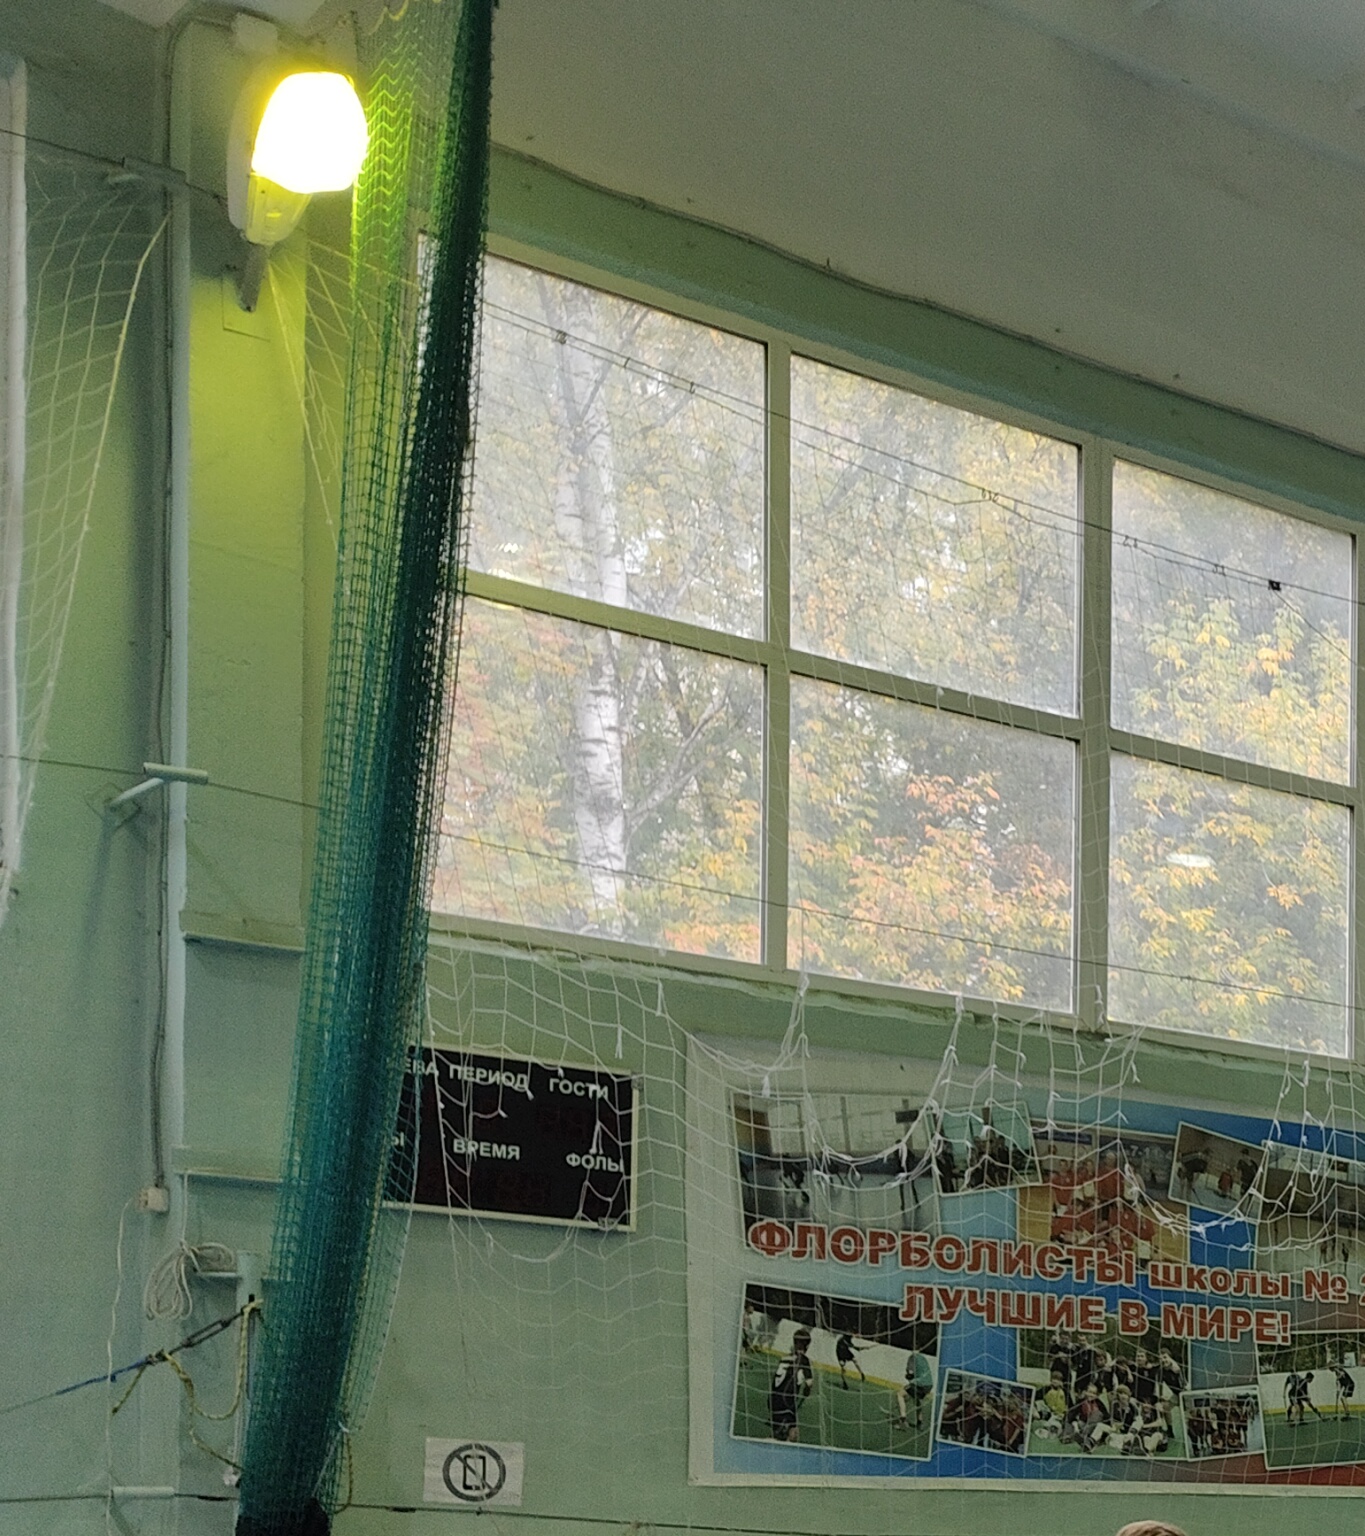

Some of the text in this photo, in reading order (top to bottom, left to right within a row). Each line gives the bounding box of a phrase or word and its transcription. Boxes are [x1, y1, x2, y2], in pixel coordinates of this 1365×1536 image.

[450, 1064, 528, 1091] ПЕРИОД
[549, 1078, 609, 1100] ГОСТИ
[453, 1138, 520, 1160] ВРЕМЯ
[566, 1152, 624, 1172] ФОЛЫ
[751, 1220, 1134, 1285] ФЛОРБОЛИСТЫ
[1304, 1268, 1347, 1302] №
[900, 1285, 1290, 1345] ЛУЧШИЕ В МИРЕ!
